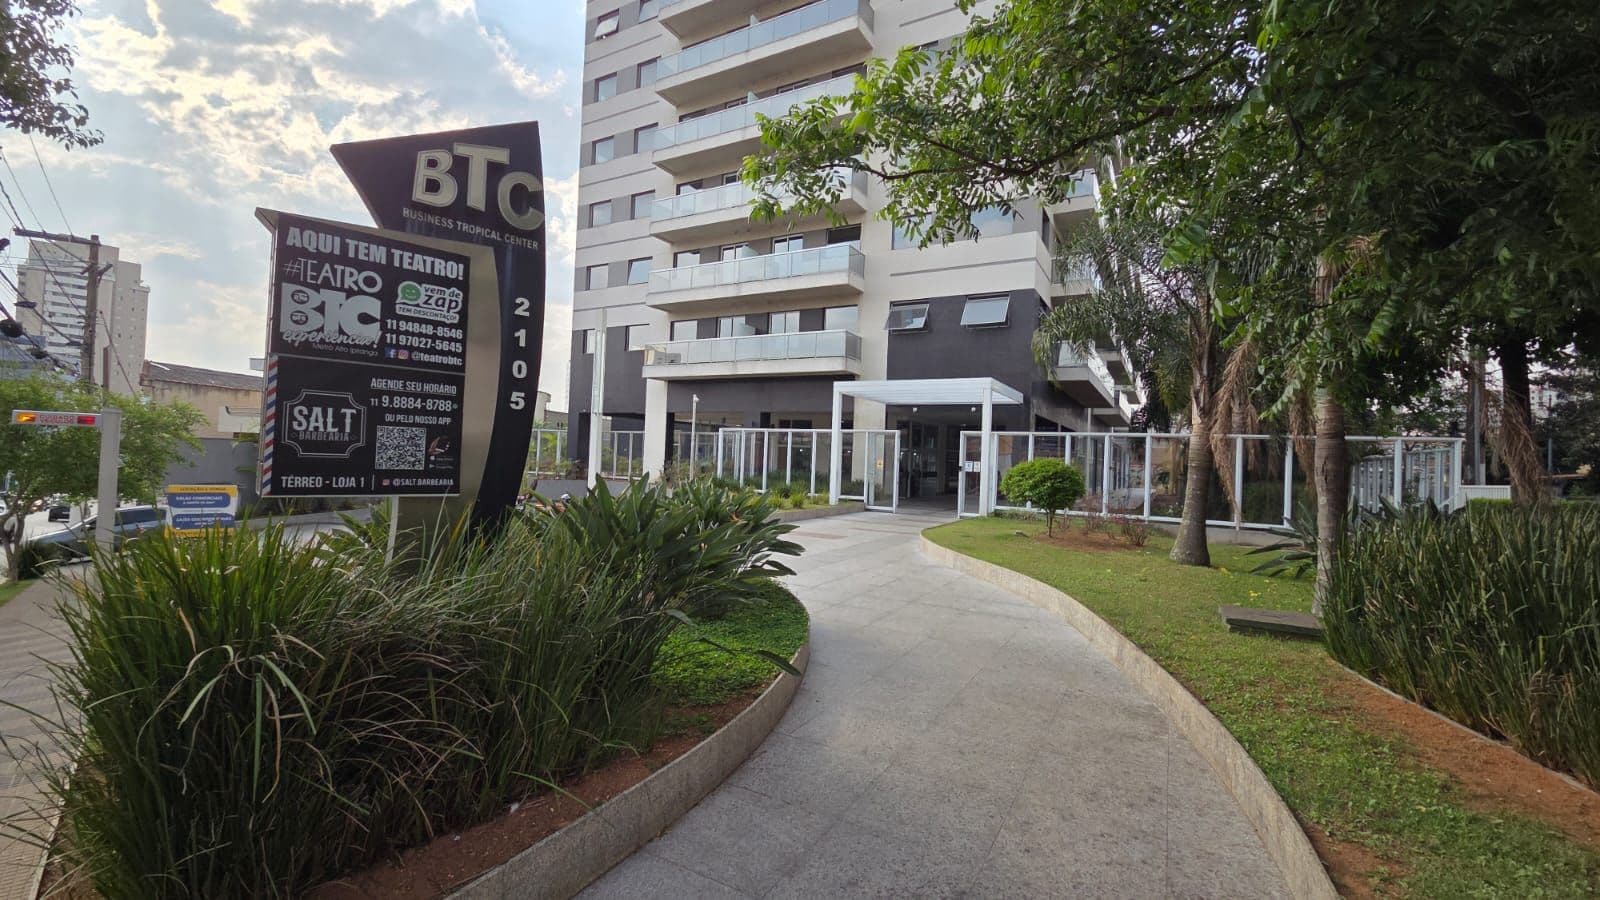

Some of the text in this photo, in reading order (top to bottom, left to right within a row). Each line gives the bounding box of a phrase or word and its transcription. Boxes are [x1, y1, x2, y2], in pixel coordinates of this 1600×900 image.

[411, 142, 545, 231] BTC
[403, 207, 539, 250] BUSINESS TROPICAL CENTER
[286, 226, 465, 281] AQUI TEM TEATRO!
[284, 257, 383, 294] #TEATRO
[424, 286, 460, 299] vem de
[280, 282, 382, 338] BTC
[422, 294, 459, 314] zap
[386, 319, 463, 340] 11 94848-8546
[385, 333, 463, 353] 11 97027-5645
[411, 350, 463, 366] @teatrobtc
[371, 378, 457, 395] AGENDE SEU HORÁRIO
[370, 395, 452, 412] 11 9.8884-8788
[292, 405, 357, 433] SALT
[385, 413, 452, 425] OU PELO NOSSO APP
[299, 431, 350, 442] BARBEARIA
[281, 474, 323, 488] TÉRREO
[332, 477, 357, 488] LOJA
[360, 477, 365, 488] 1
